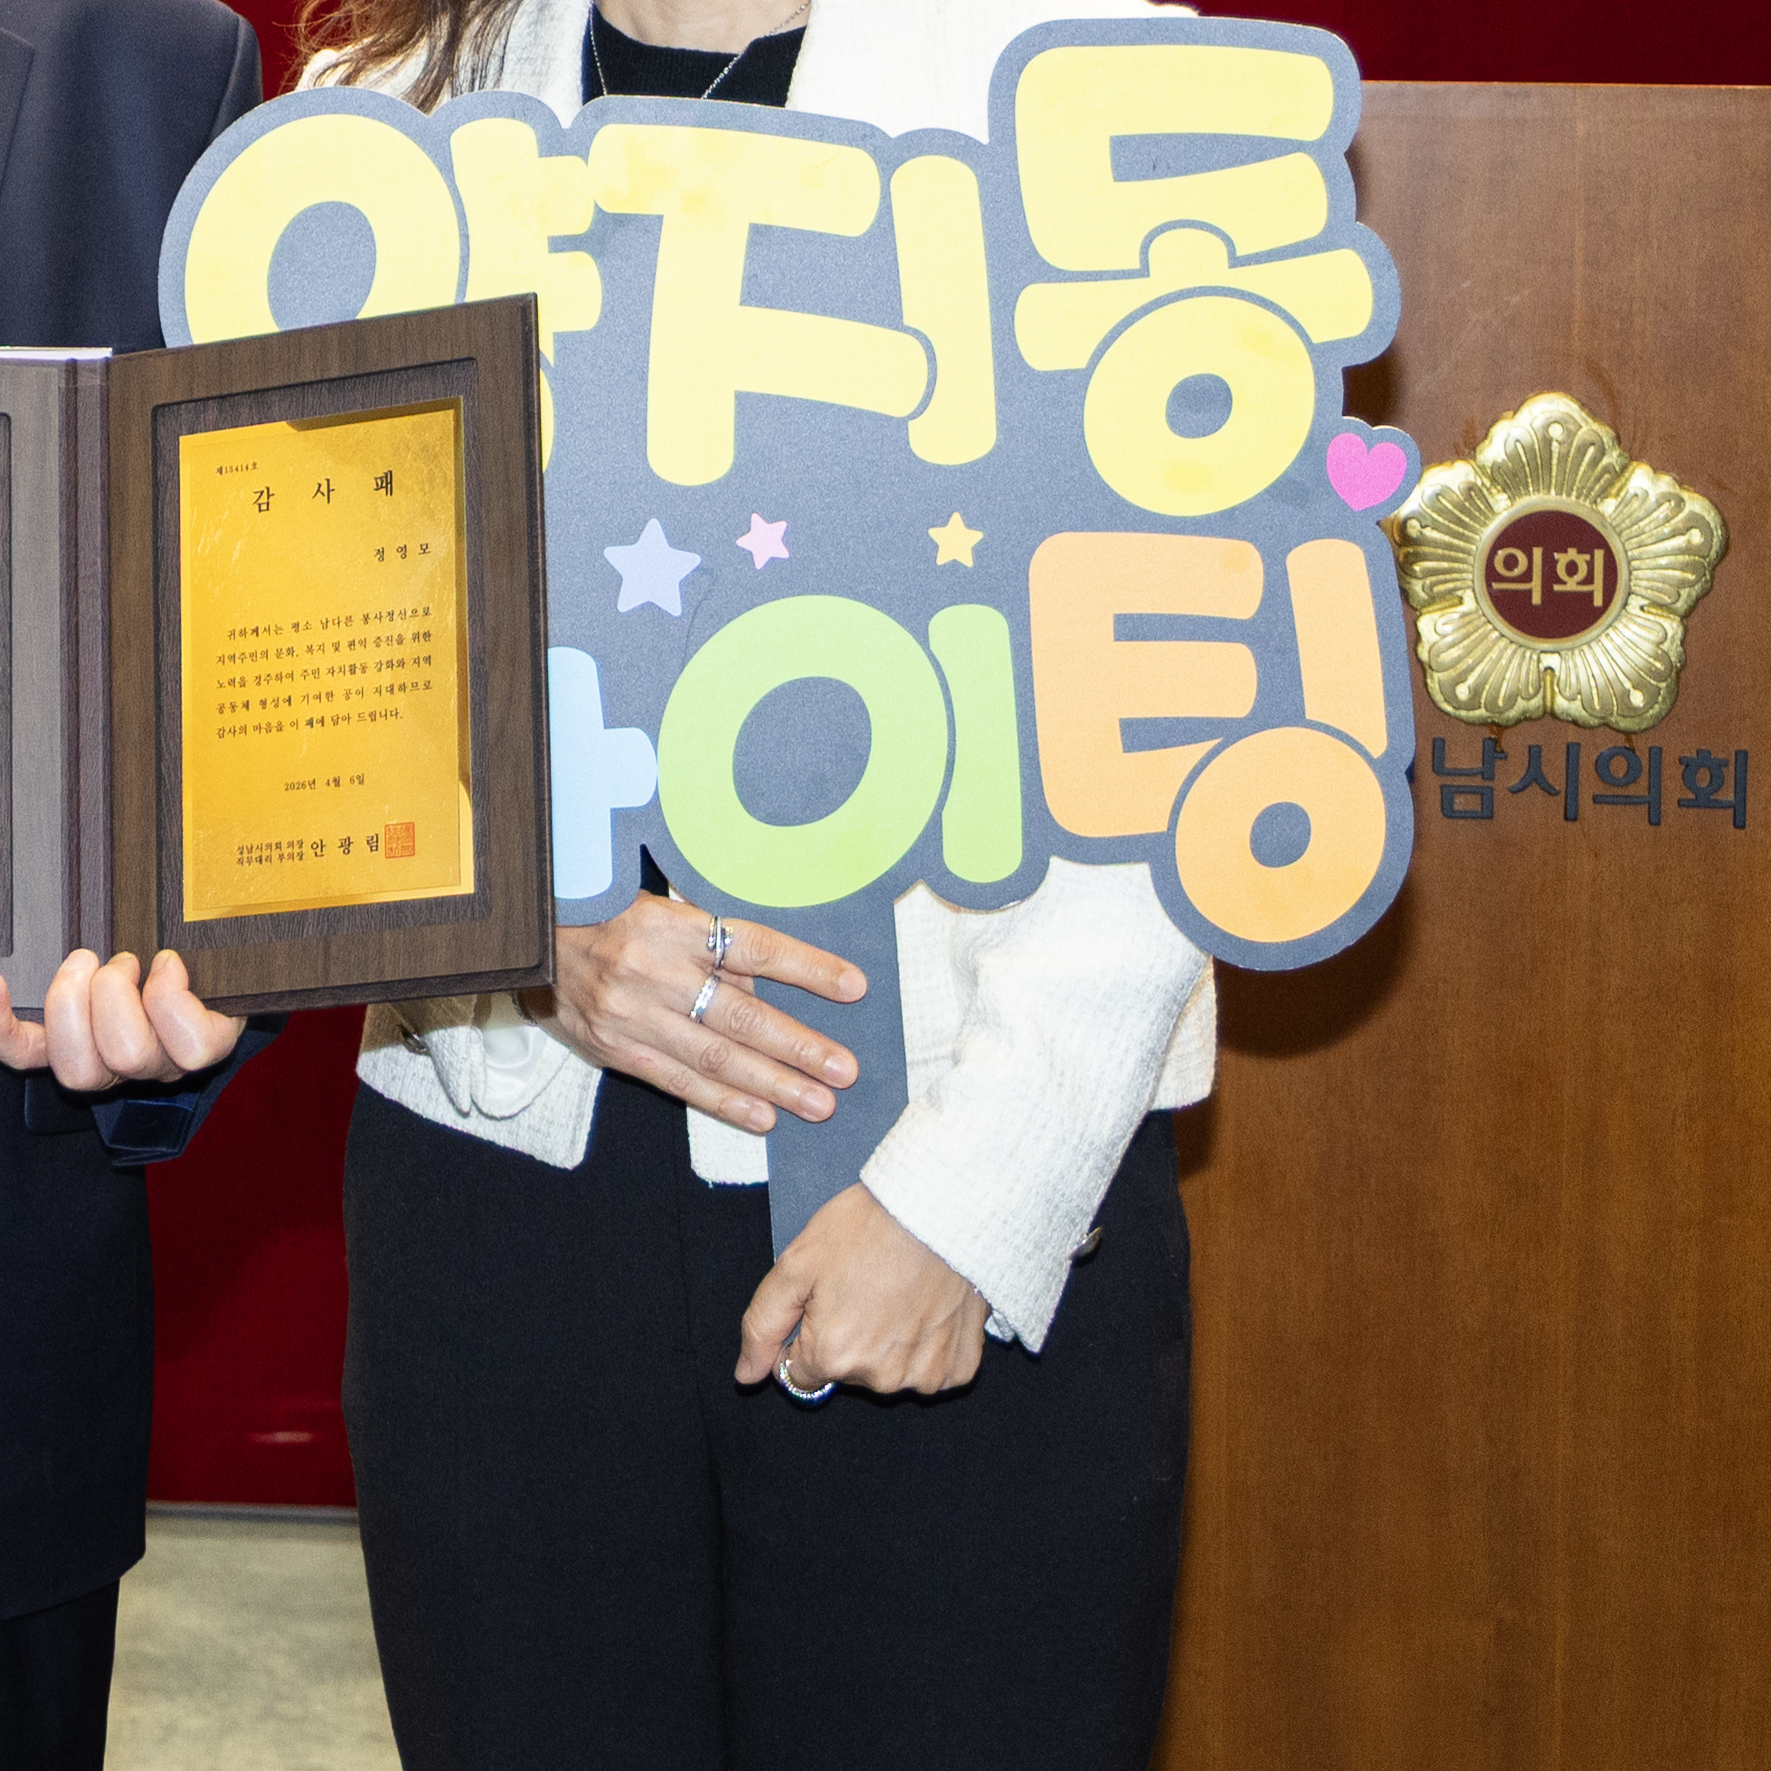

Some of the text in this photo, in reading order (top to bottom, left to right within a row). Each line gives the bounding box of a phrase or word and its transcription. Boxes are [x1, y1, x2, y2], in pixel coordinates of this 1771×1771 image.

[215, 462, 259, 475] 제15414호
[253, 470, 394, 513] 감사패
[1492, 547, 1605, 607] 의회
[227, 606, 432, 640] 귀하께서는 평소 남다른 봉사정신으로
[216, 650, 269, 666] 지역주민의
[305, 643, 325, 655] 복지
[332, 641, 340, 653] 및
[347, 638, 367, 651] 편익
[373, 633, 405, 648] 증진을
[411, 630, 431, 643] 위한
[216, 655, 431, 689] 노력을 경주하여 주민 자치활동 강화와 지역
[217, 680, 433, 714] 공동체 형성에 기여한 공이 지대하므로
[217, 707, 403, 739] 감사의 마음을 이 패에 담아 드립니다.
[284, 773, 365, 791] 2026년 4월 6일
[1431, 737, 1748, 829] 남시의회
[236, 851, 304, 866] 직무대리 부의장
[237, 839, 304, 855] 성남시의회 의장
[311, 833, 379, 857] 안광림
